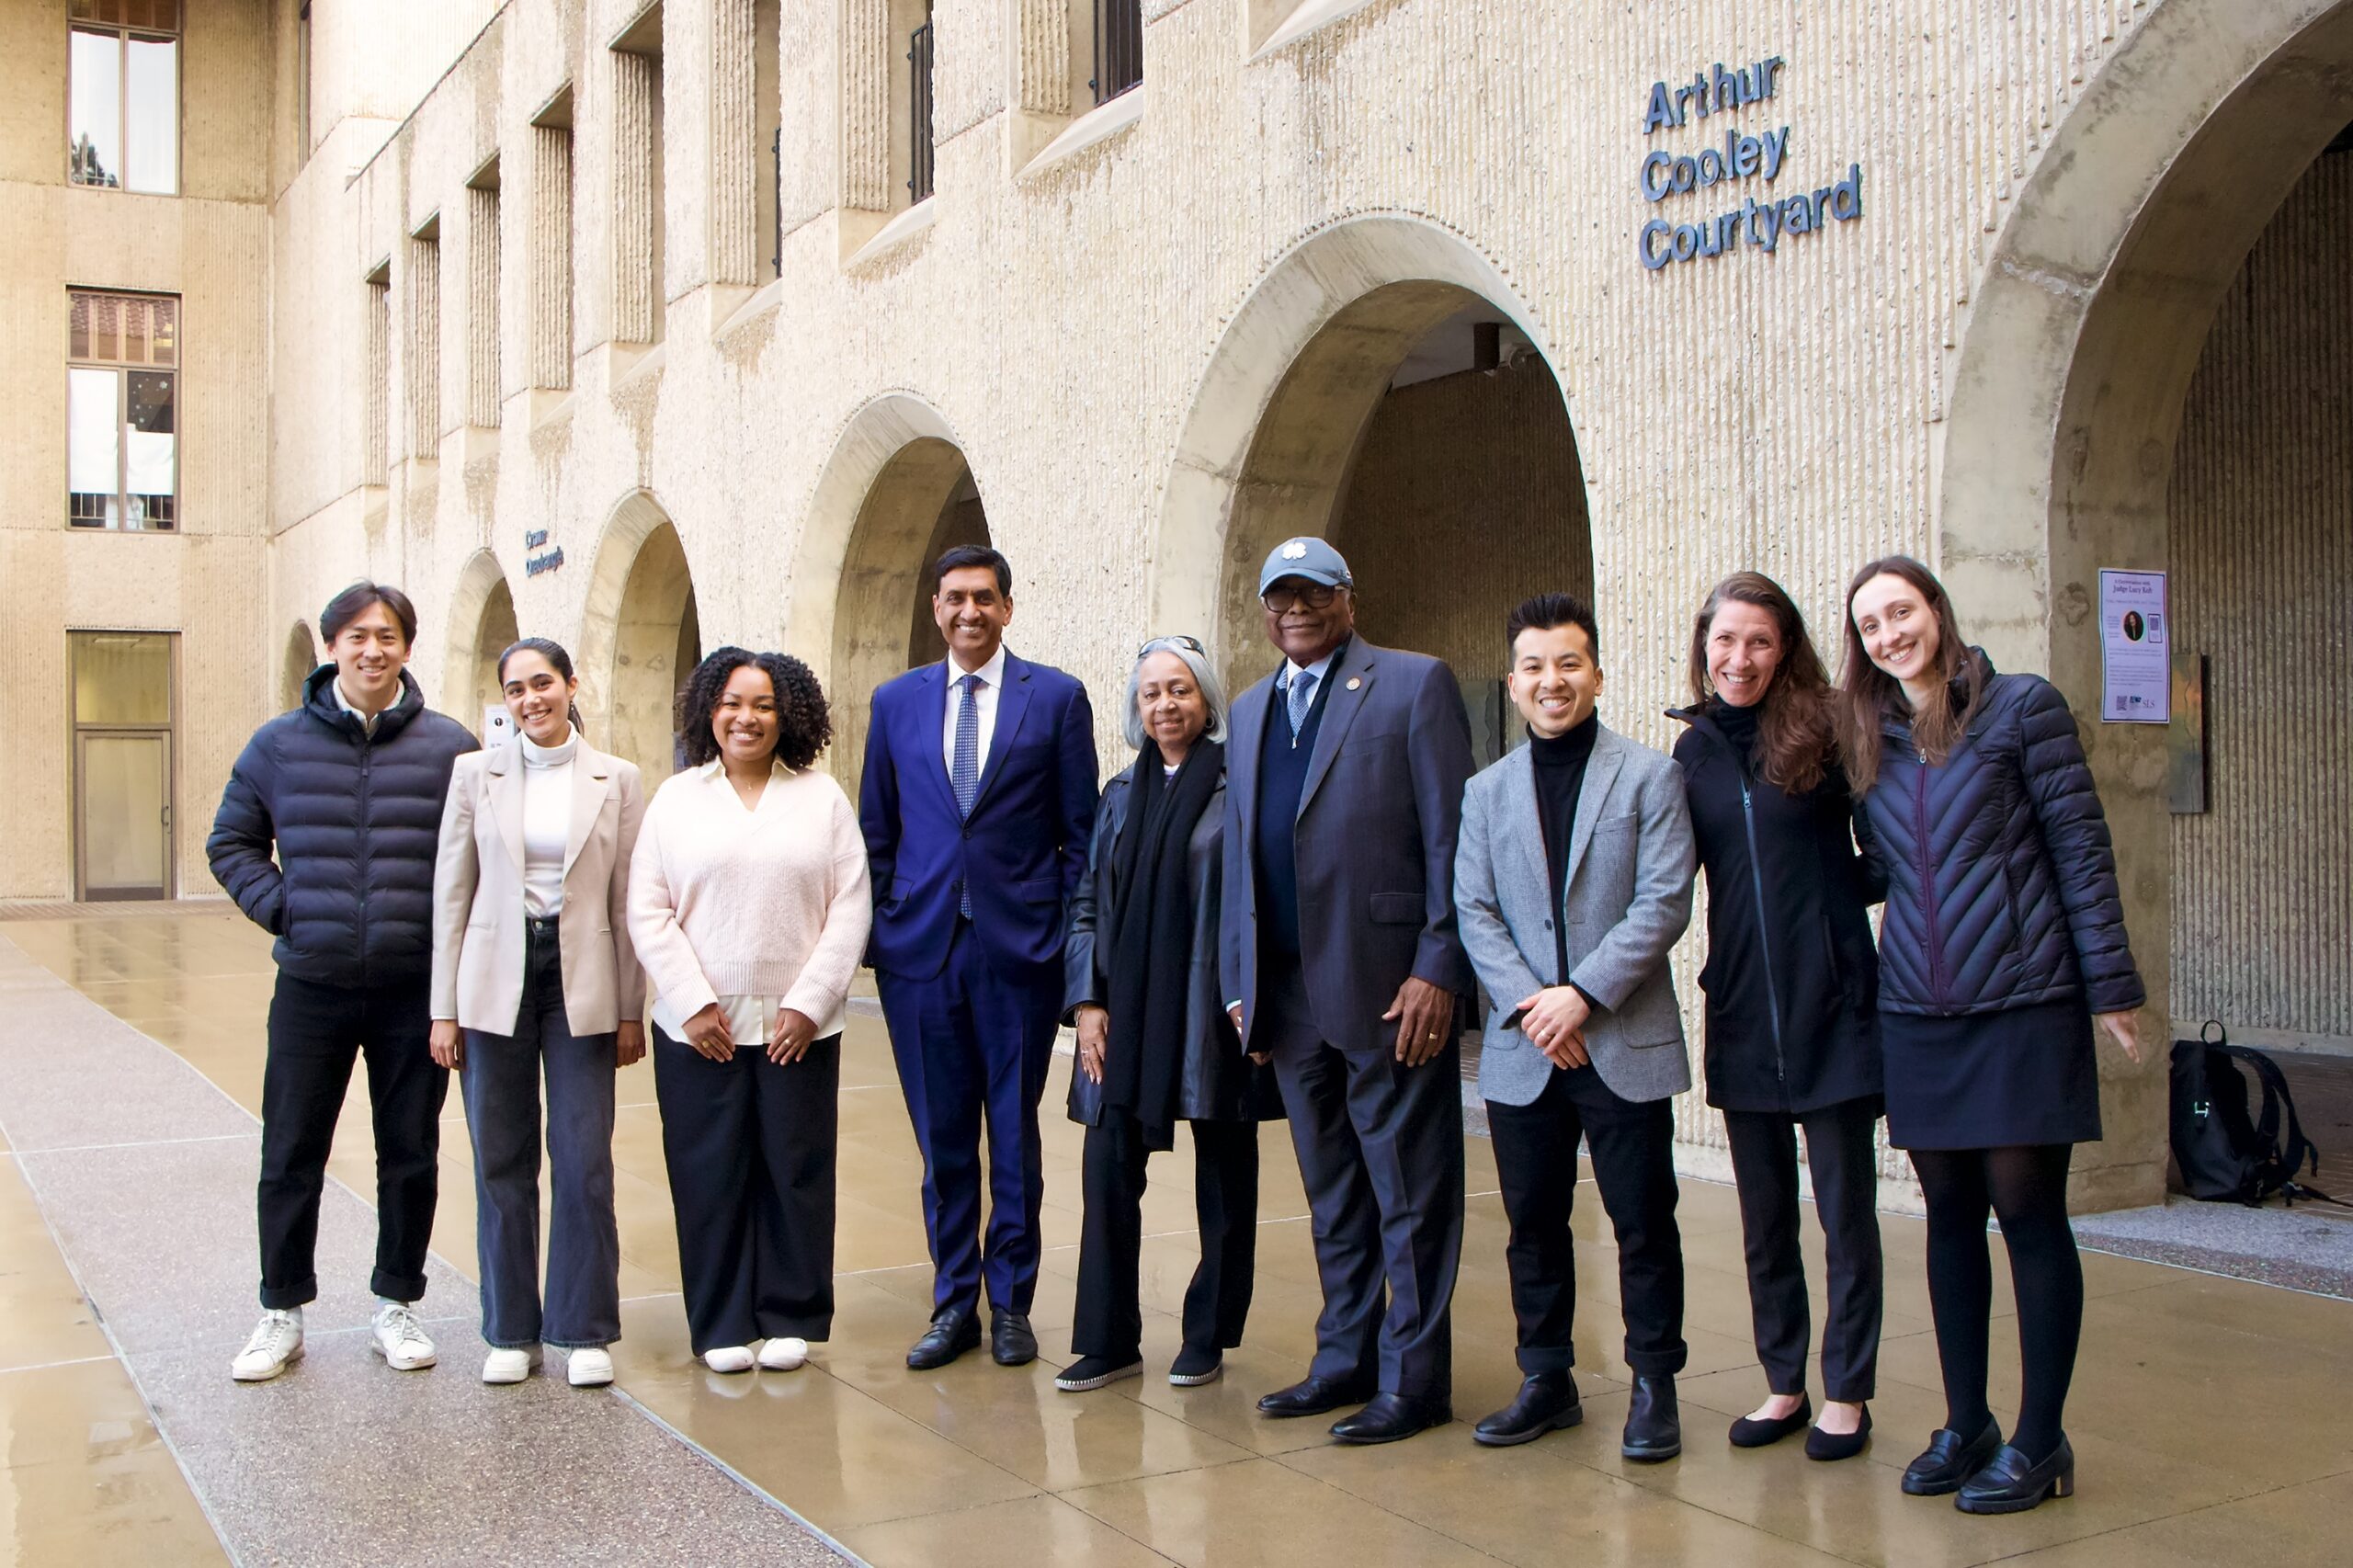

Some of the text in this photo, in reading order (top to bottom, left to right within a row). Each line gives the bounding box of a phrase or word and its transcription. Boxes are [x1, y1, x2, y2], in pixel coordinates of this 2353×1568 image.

[1643, 56, 1781, 135] Arthur
[1641, 126, 1790, 202] Cooley
[1639, 164, 1861, 270] Courtyard
[2112, 585, 2128, 594] Judge
[2128, 585, 2142, 595] Lucy
